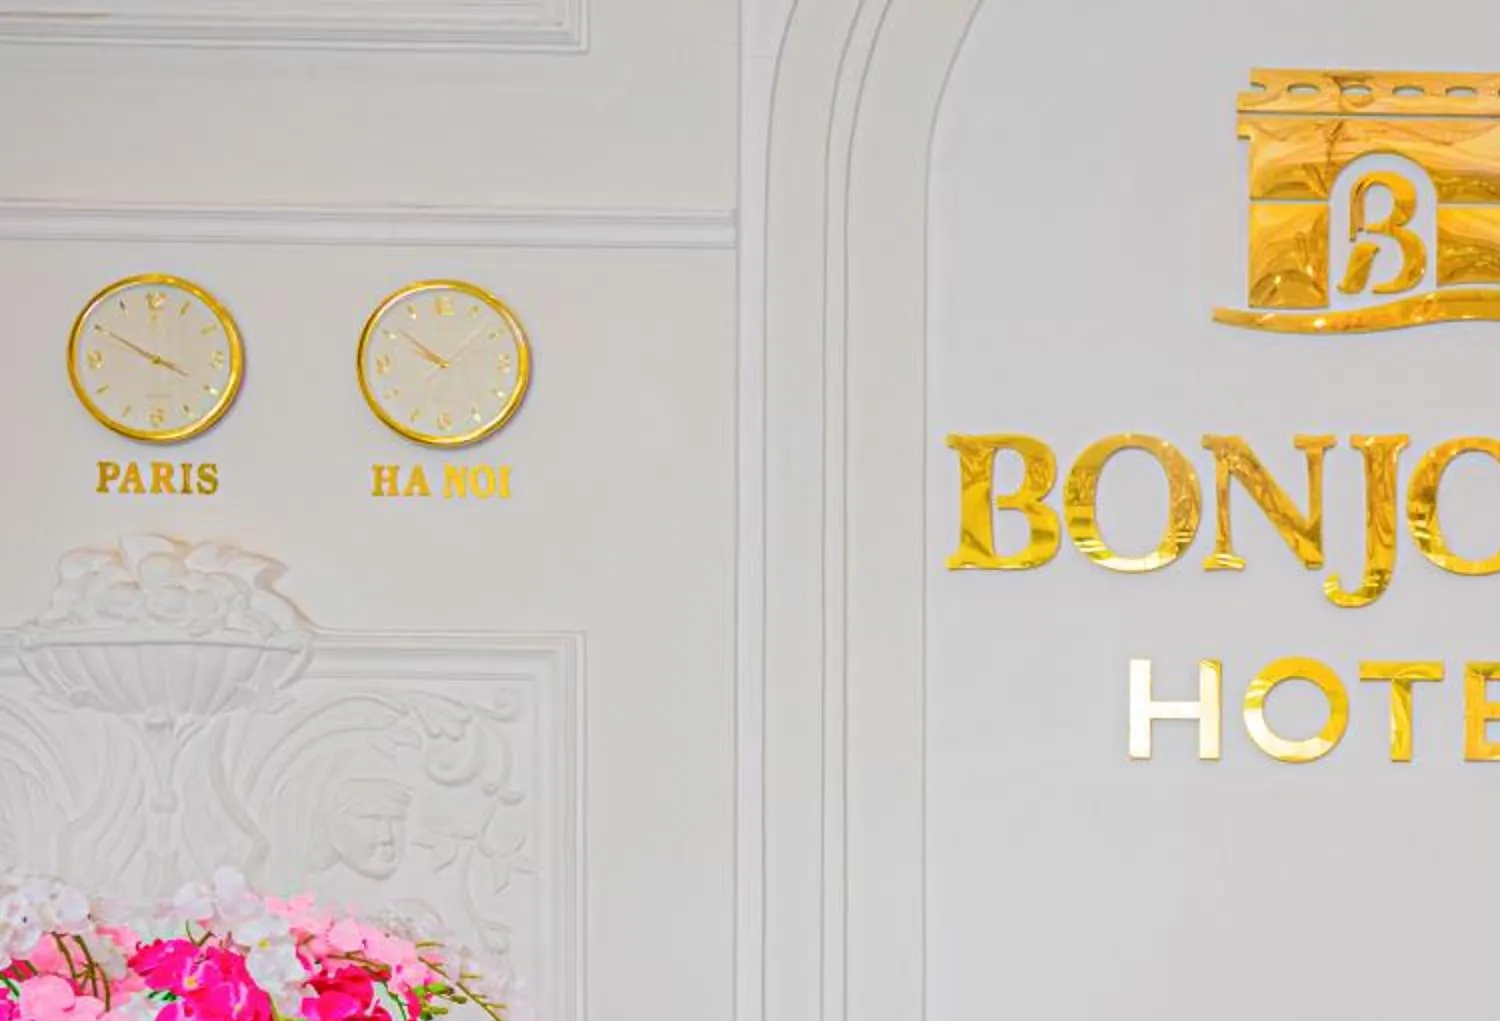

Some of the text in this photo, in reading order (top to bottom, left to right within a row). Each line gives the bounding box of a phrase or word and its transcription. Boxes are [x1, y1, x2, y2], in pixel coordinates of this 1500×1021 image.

[1336, 170, 1429, 296] B
[96, 461, 219, 496] PARIS
[372, 463, 512, 499] HA NOI
